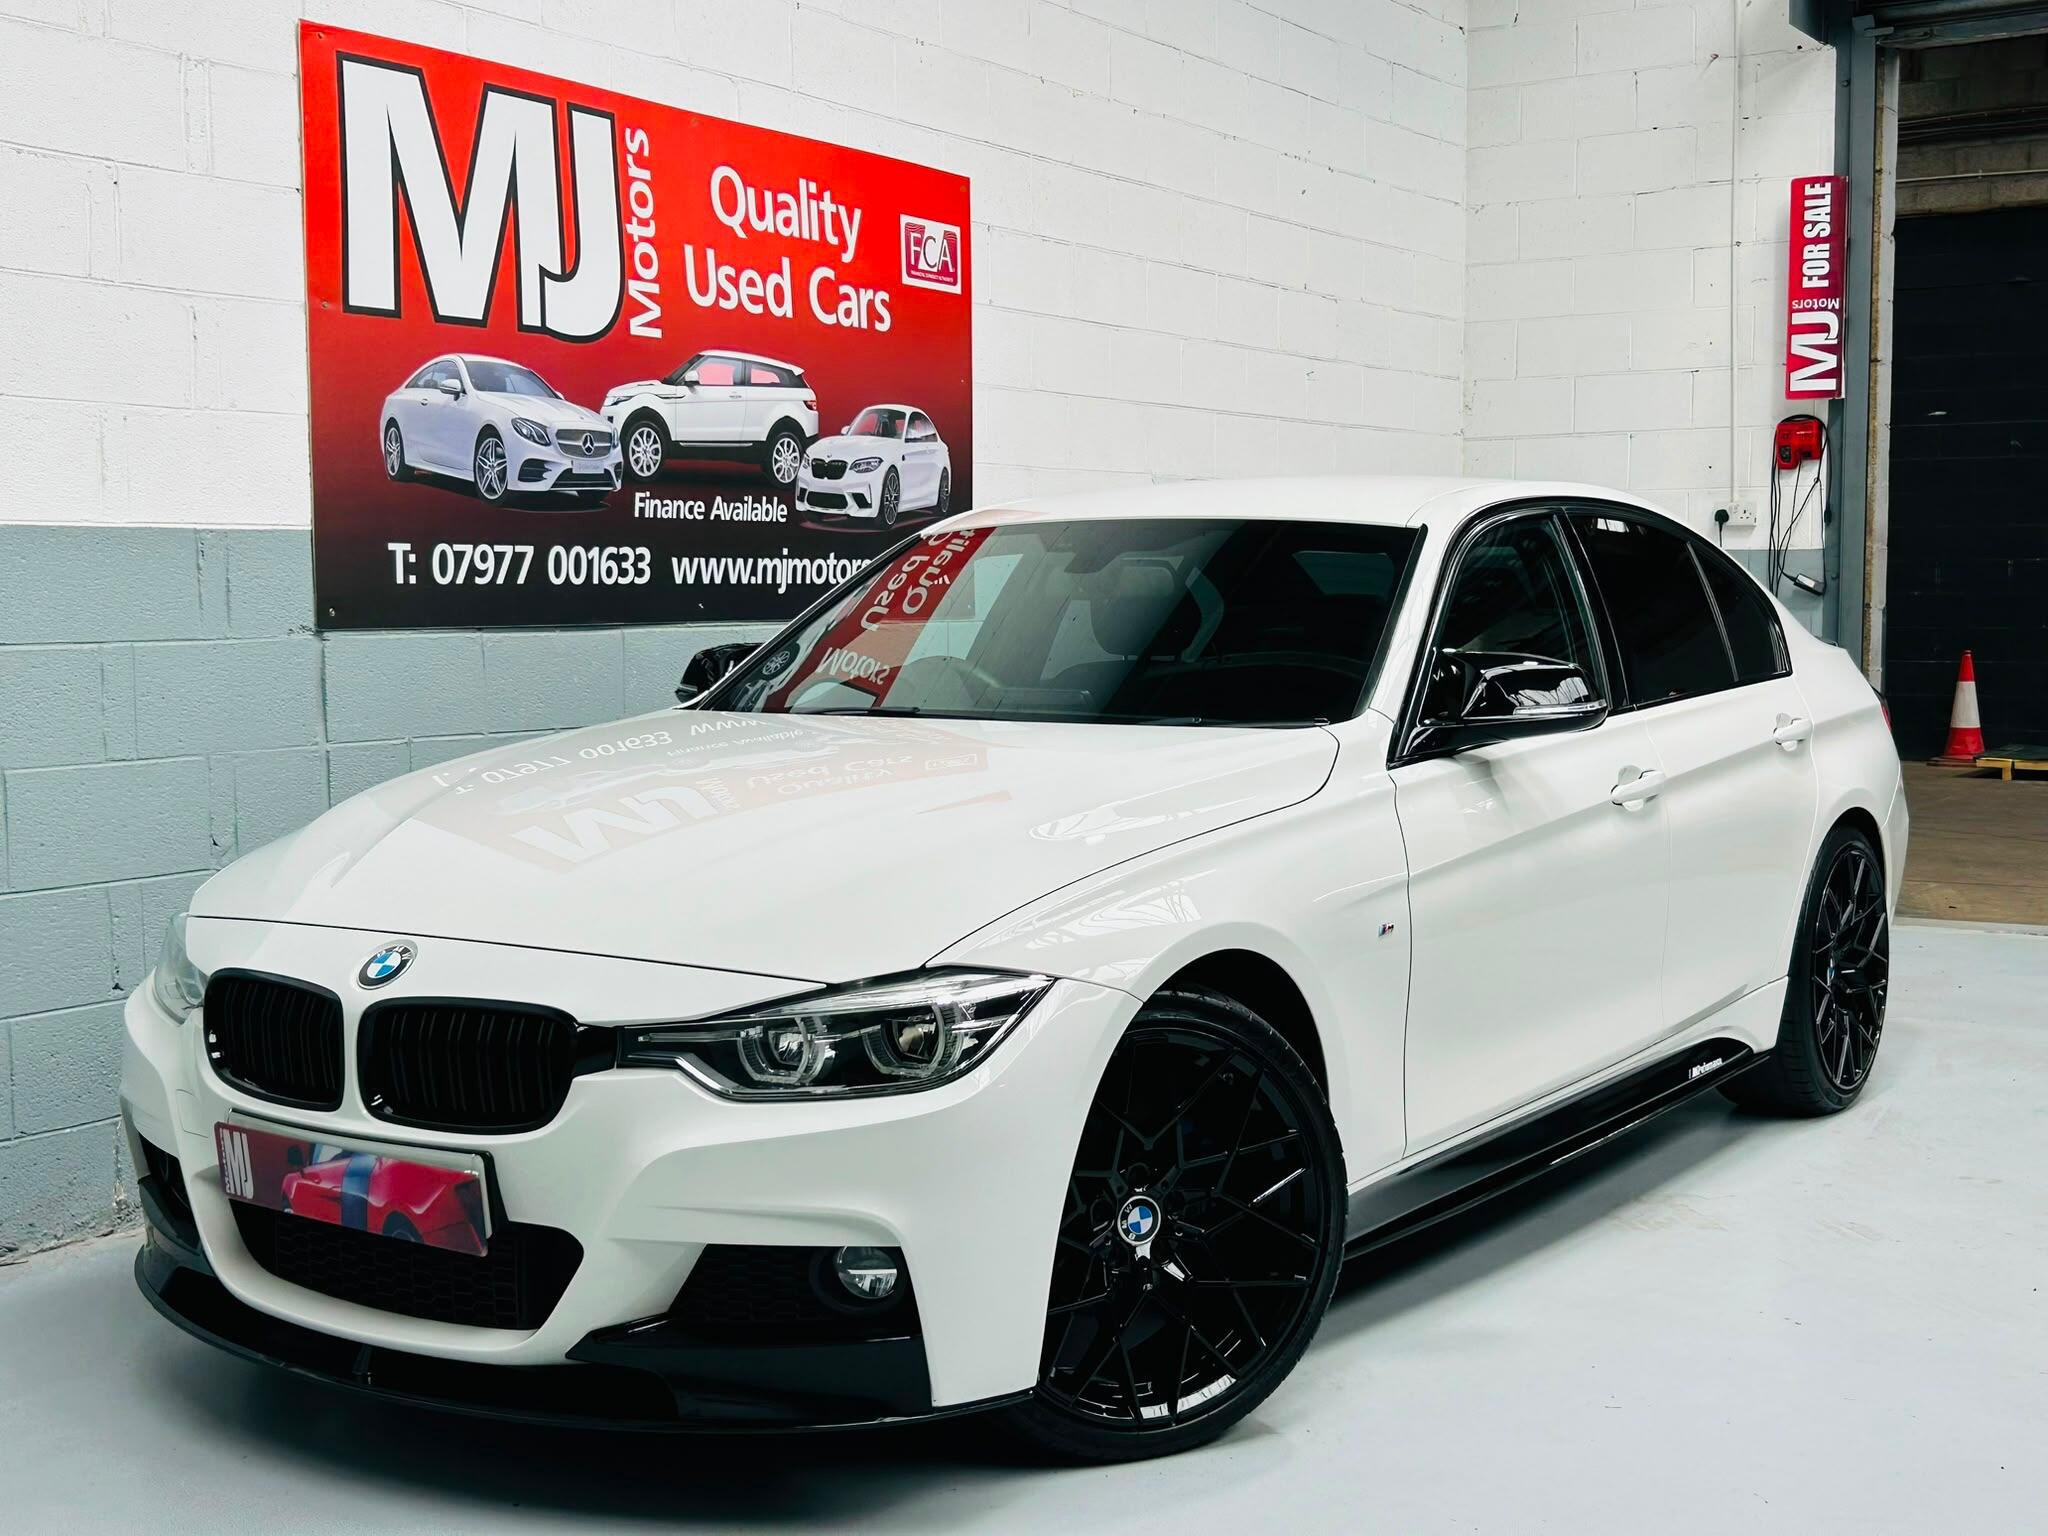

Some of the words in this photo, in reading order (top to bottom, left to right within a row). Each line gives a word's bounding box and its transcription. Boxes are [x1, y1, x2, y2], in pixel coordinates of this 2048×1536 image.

[338, 55, 624, 342] MJ
[709, 165, 862, 263] Quality
[1803, 182, 1832, 239] SALE
[624, 127, 662, 339] Motors
[910, 231, 955, 273] FCA
[683, 243, 793, 318] Used
[808, 266, 891, 332] Cars
[1802, 243, 1830, 289] FOR
[1792, 298, 1840, 309] Motors
[1789, 310, 1840, 392] MJ
[634, 492, 705, 520] Finance
[710, 495, 788, 522] Available
[387, 542, 417, 585] T:
[432, 543, 534, 585] 07977
[547, 545, 651, 585] 001633
[222, 1127, 254, 1199] MJ
